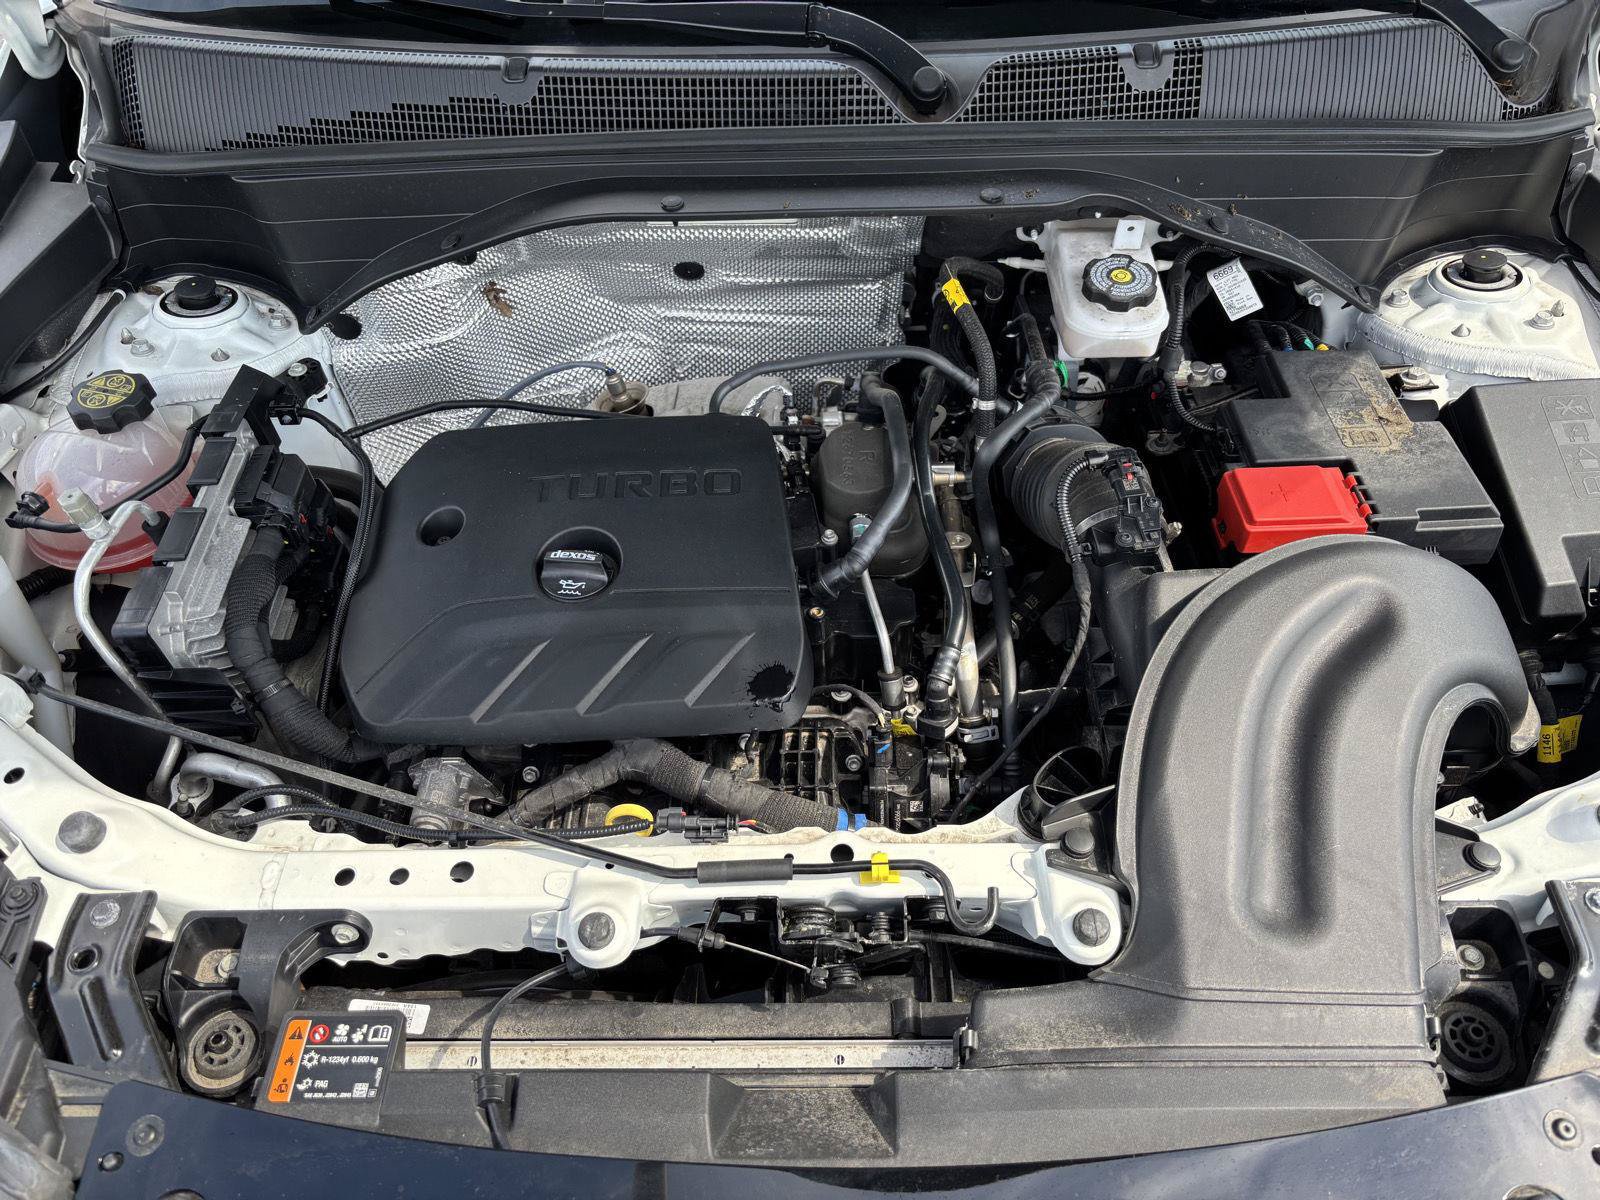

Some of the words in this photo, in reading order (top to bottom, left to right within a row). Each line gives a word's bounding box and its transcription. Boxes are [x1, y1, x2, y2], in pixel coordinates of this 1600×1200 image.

[1213, 265, 1234, 280] 6669
[528, 468, 742, 502] TURBO
[550, 549, 596, 561] dexos
[1542, 733, 1552, 756] 1146
[321, 1055, 349, 1065] R-1234yf
[351, 1055, 370, 1064] 0.600
[370, 1055, 379, 1065] kg
[314, 1080, 329, 1088] PAG
